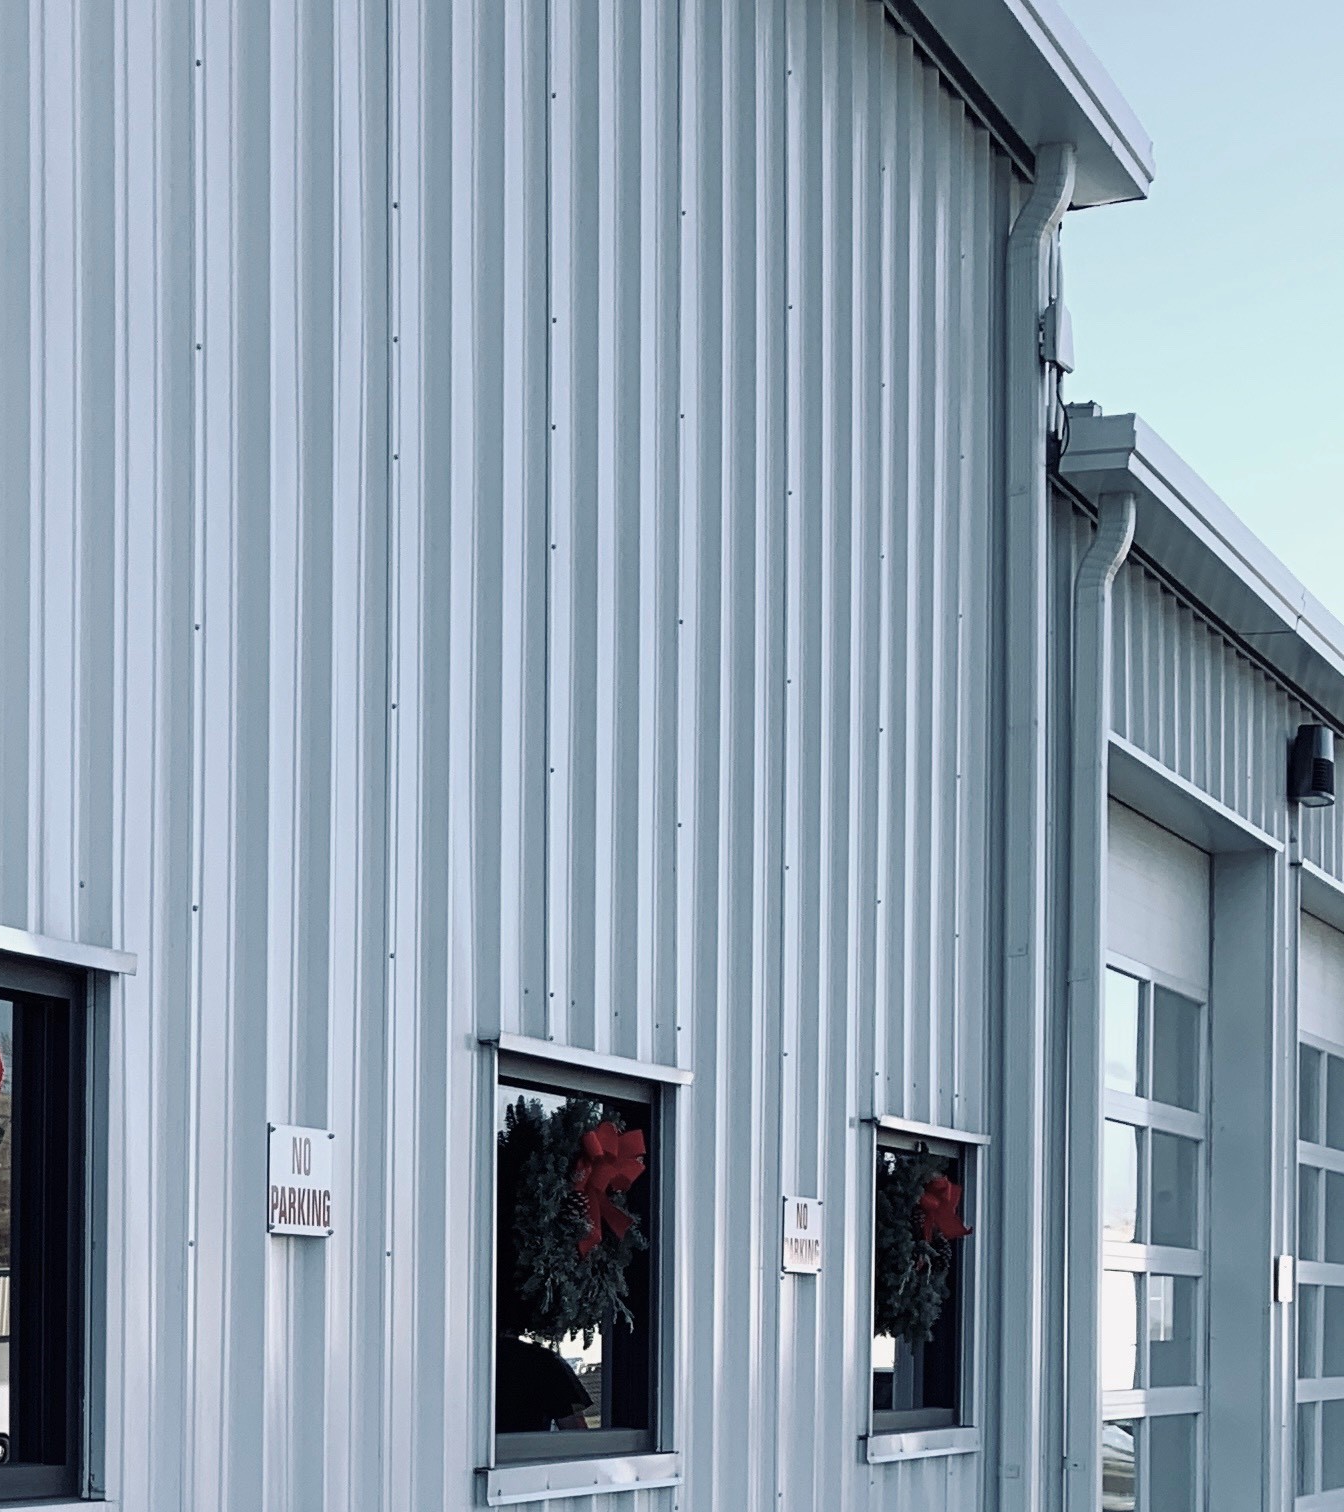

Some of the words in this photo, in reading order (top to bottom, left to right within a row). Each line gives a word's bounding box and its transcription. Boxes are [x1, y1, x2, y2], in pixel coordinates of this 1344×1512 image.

[292, 1136, 311, 1176] NO
[271, 1185, 331, 1228] PARKING
[796, 1203, 808, 1230] NO
